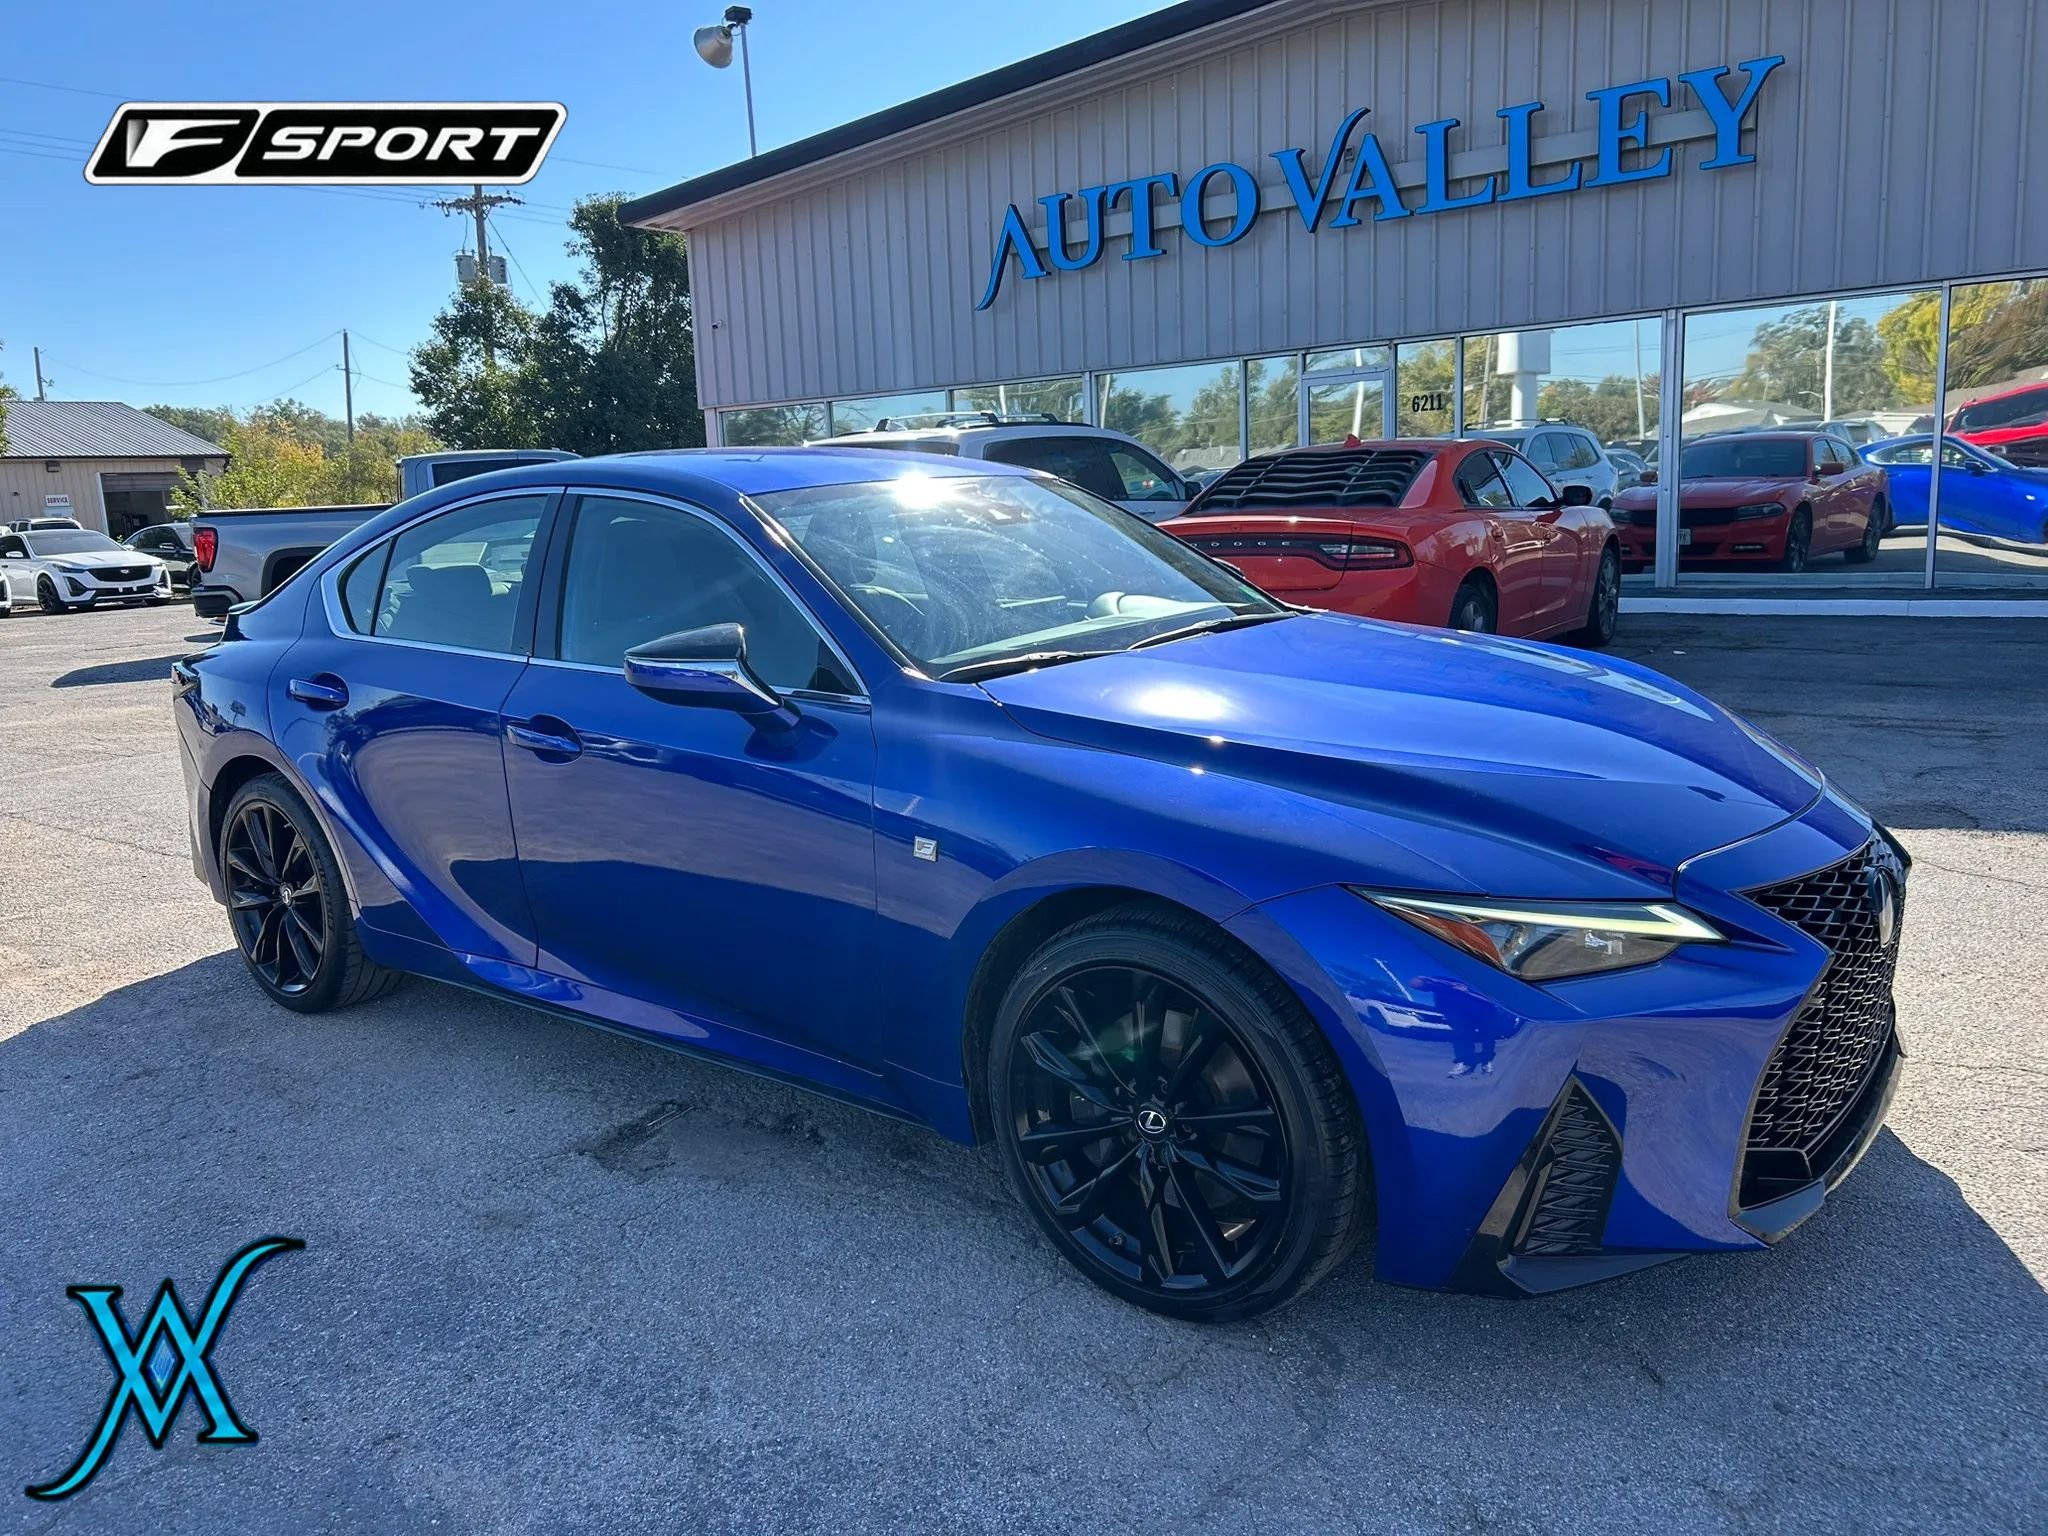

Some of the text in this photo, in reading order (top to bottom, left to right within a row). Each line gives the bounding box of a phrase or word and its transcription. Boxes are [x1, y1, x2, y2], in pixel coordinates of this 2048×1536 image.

[975, 55, 1785, 311] AUTO VALLEY
[1412, 393, 1444, 412] 6211
